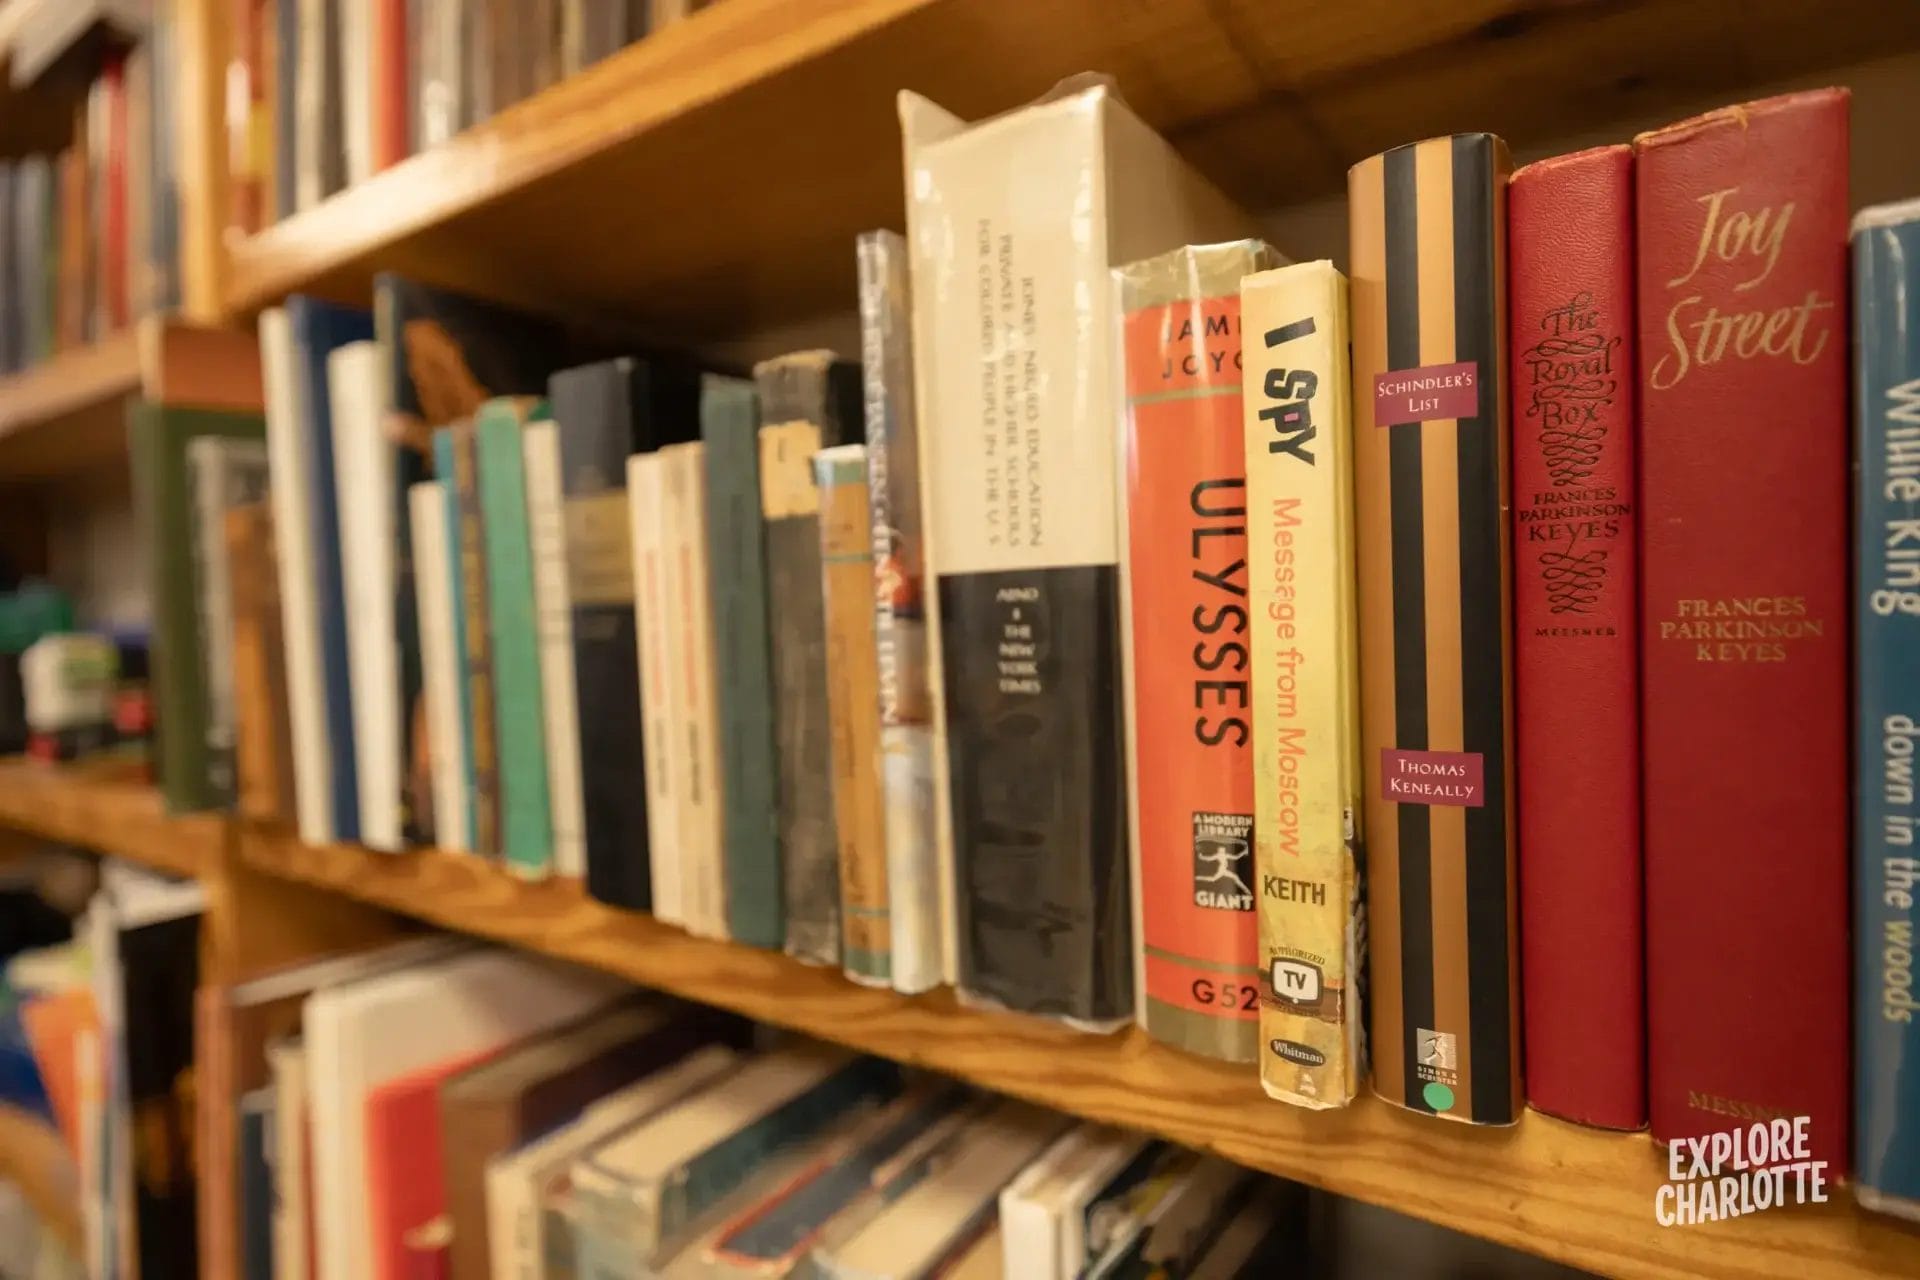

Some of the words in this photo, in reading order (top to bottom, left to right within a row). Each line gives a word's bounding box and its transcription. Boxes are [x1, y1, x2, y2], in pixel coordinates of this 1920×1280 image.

[1667, 186, 1796, 292] Joy
[1541, 291, 1600, 336] The
[1264, 316, 1317, 348] I
[1650, 291, 1834, 391] Street
[1525, 337, 1621, 385] Royal
[1378, 372, 1473, 397] SCHINDLER'S
[1408, 398, 1439, 412] LIST
[1542, 401, 1600, 429] Box
[1534, 488, 1617, 505] FRANCES
[1519, 504, 1631, 522] PARKINSON
[1528, 520, 1620, 544] KEYES
[1269, 498, 1302, 640] Message
[1190, 478, 1249, 748] ULYSSES
[1678, 597, 1806, 618] FRANCES
[1660, 620, 1824, 639] PARKINSON
[1696, 643, 1786, 662] KEYES
[1276, 647, 1304, 718] from
[1397, 758, 1466, 778] THOMAS
[1883, 714, 1920, 805] down
[1278, 728, 1307, 857] Moscow
[1391, 778, 1474, 799] KENEALLY
[1198, 825, 1249, 838] LIBRARY
[1203, 814, 1253, 827] MODERN
[1884, 815, 1920, 847] in
[1264, 875, 1326, 906] KEITH
[1883, 857, 1920, 911] the
[1196, 891, 1253, 910] GIANT
[1283, 970, 1307, 990] TV
[1883, 920, 1920, 1024] woods
[1273, 1040, 1324, 1064] Whitman
